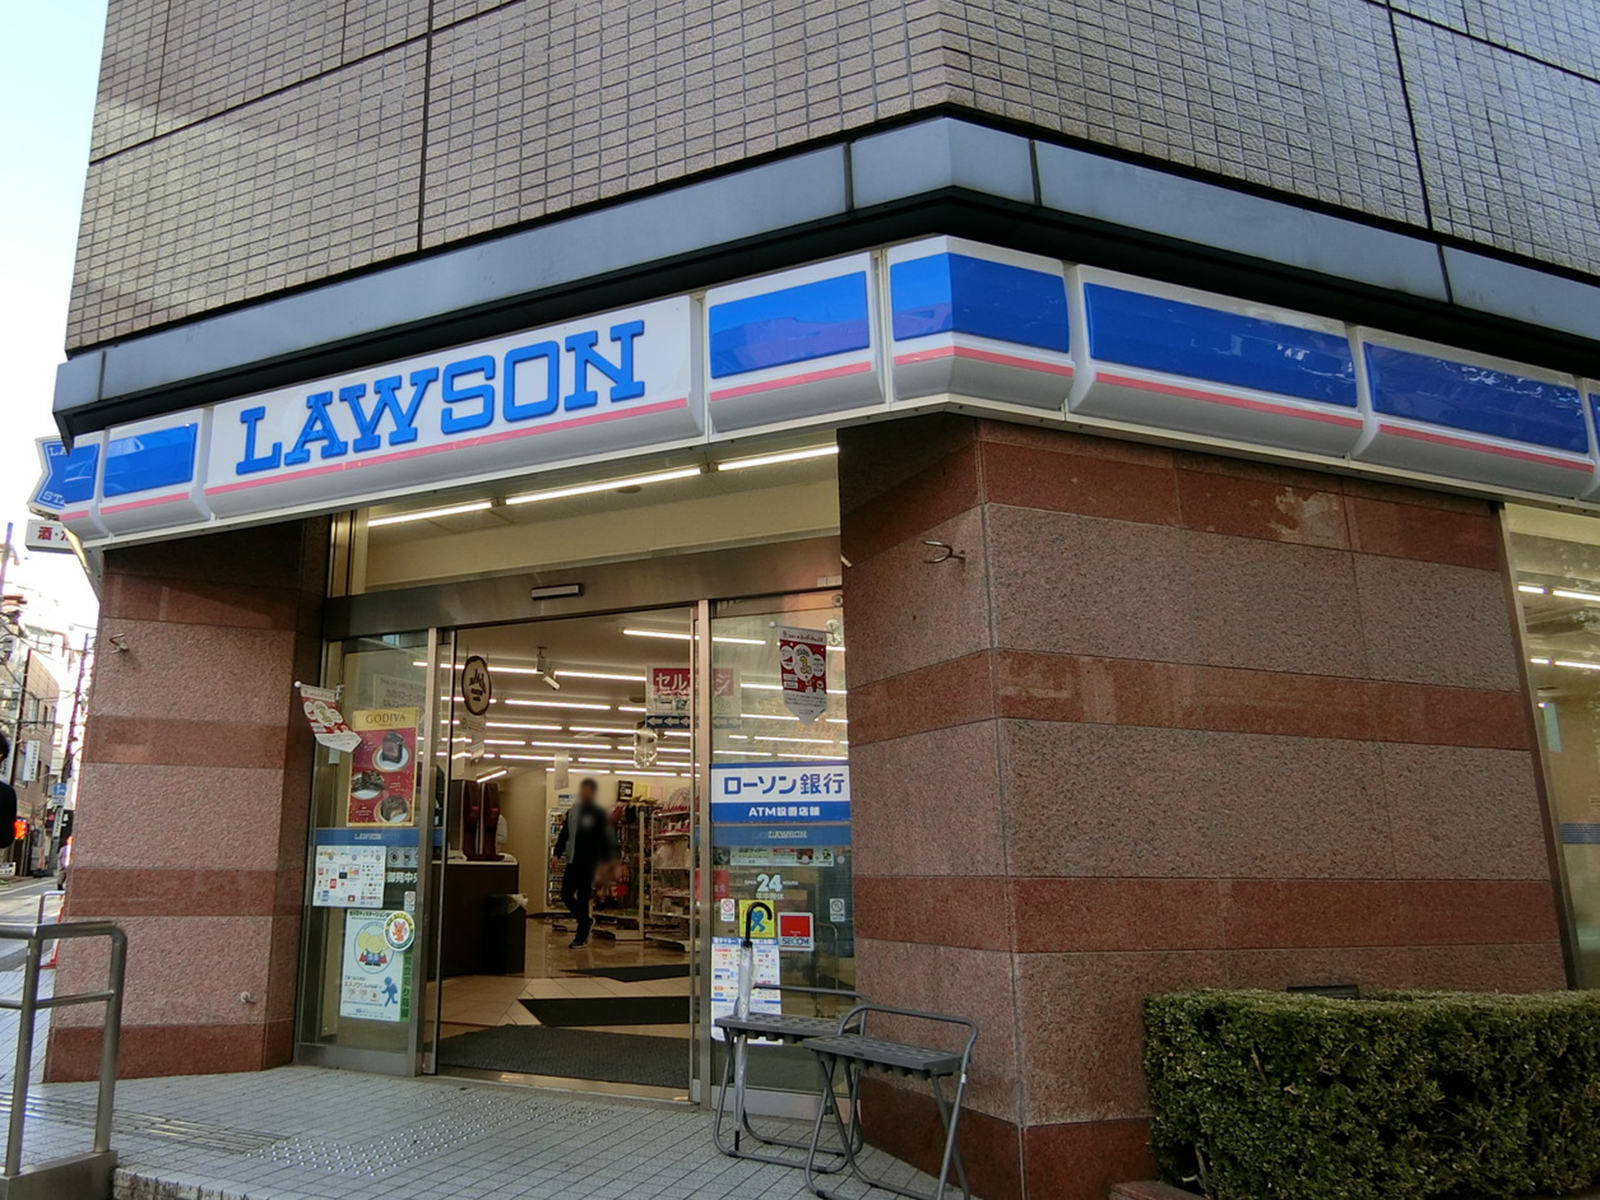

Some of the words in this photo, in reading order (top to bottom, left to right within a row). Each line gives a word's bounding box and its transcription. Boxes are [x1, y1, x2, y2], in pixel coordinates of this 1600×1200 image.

[235, 320, 645, 475] LAWSON
[366, 712, 406, 724] GODIVA
[723, 773, 845, 795] ローソン銀行
[748, 806, 820, 817] ATM設置店舗
[756, 873, 783, 892] 24
[781, 937, 809, 946] SECOM
